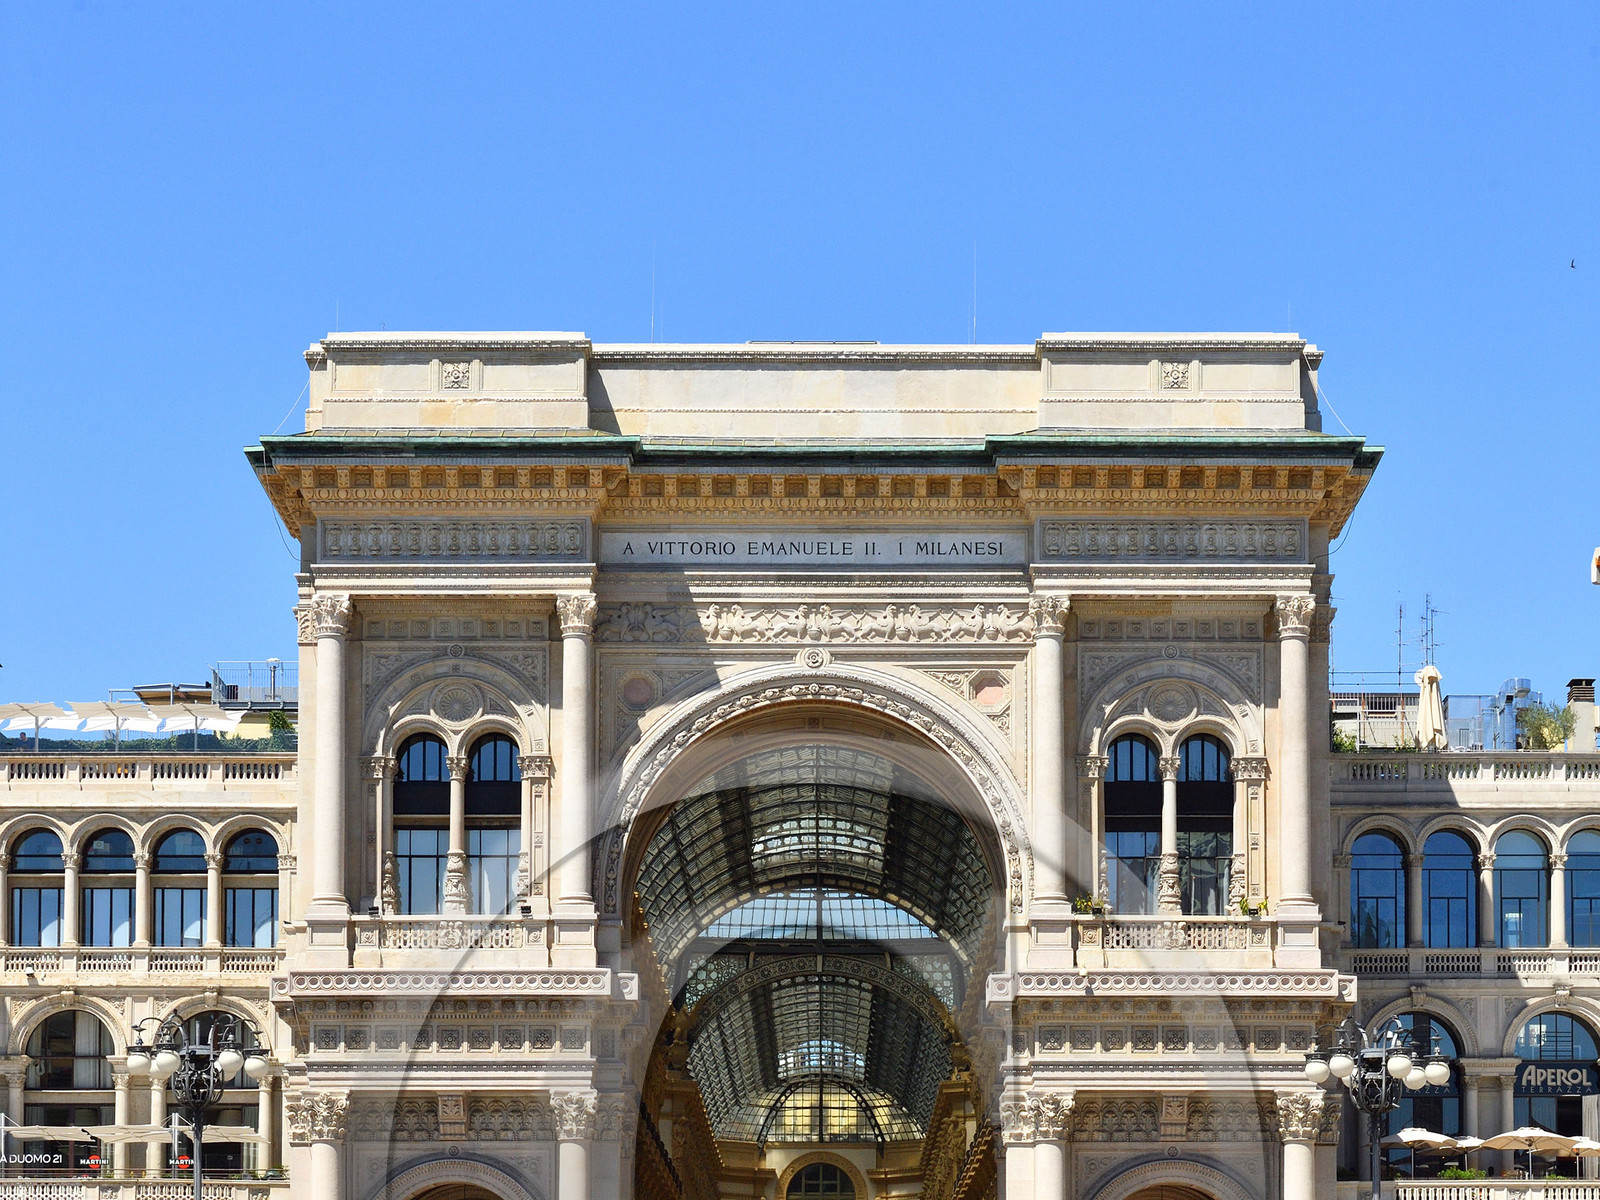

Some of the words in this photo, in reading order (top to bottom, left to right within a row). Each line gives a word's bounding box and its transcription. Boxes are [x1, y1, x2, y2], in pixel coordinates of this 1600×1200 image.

[622, 541, 635, 555] A
[647, 541, 736, 555] VITTORIO
[747, 541, 853, 555] EMANUELE
[864, 541, 882, 555] II.
[915, 541, 1003, 555] MILANESI
[1521, 1065, 1592, 1086] APEROL
[9, 1154, 51, 1163] DUOMO
[52, 1154, 62, 1163] 21
